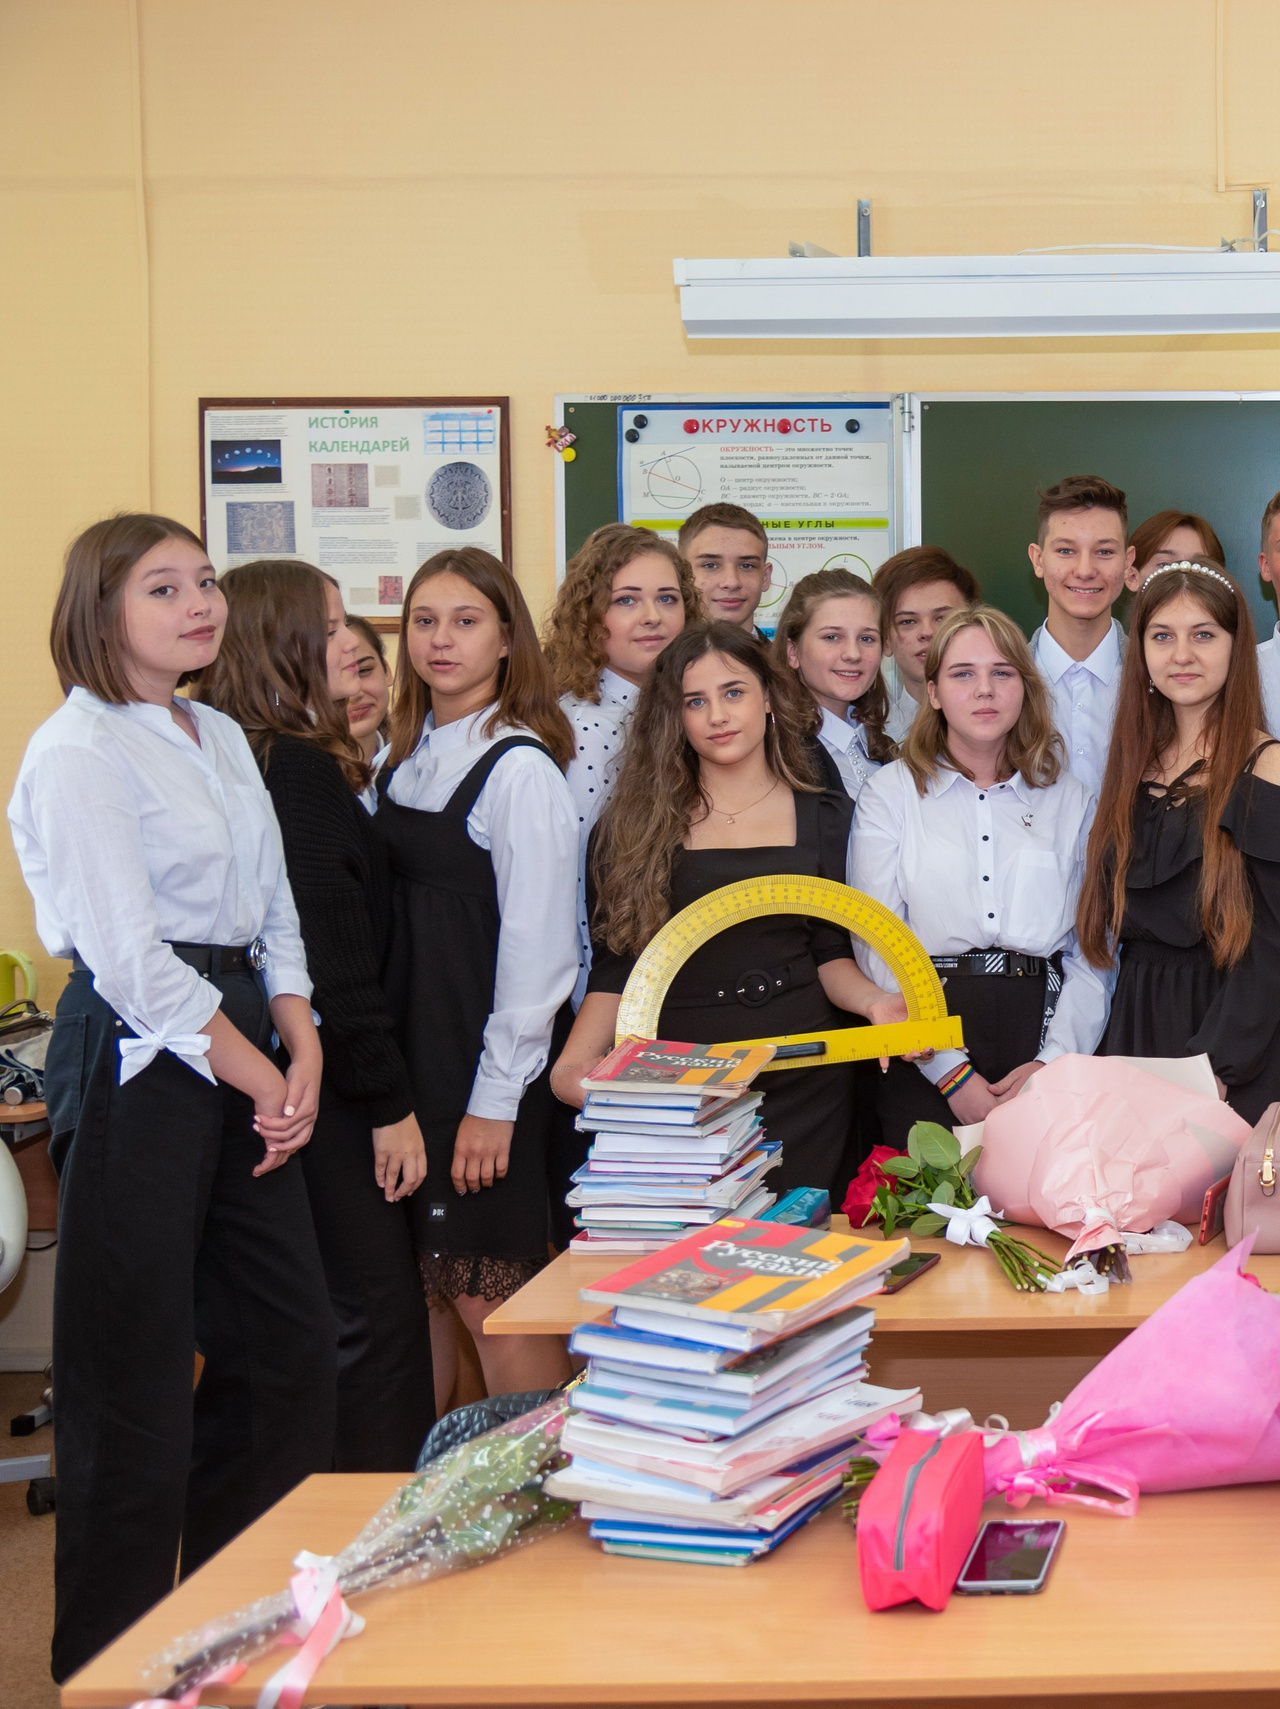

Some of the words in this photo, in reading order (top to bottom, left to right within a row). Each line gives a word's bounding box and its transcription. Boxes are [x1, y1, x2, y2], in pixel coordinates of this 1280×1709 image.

[308, 416, 379, 429] ИСТОРИЯ
[684, 418, 832, 434] КРУЖНСТЬ
[308, 437, 410, 454] КАЛЕНДАРЕЙ
[798, 520, 835, 528] УГЛЫ
[634, 1051, 743, 1065] Русский
[699, 1239, 843, 1274] Русский
[742, 1256, 829, 1279] язык
